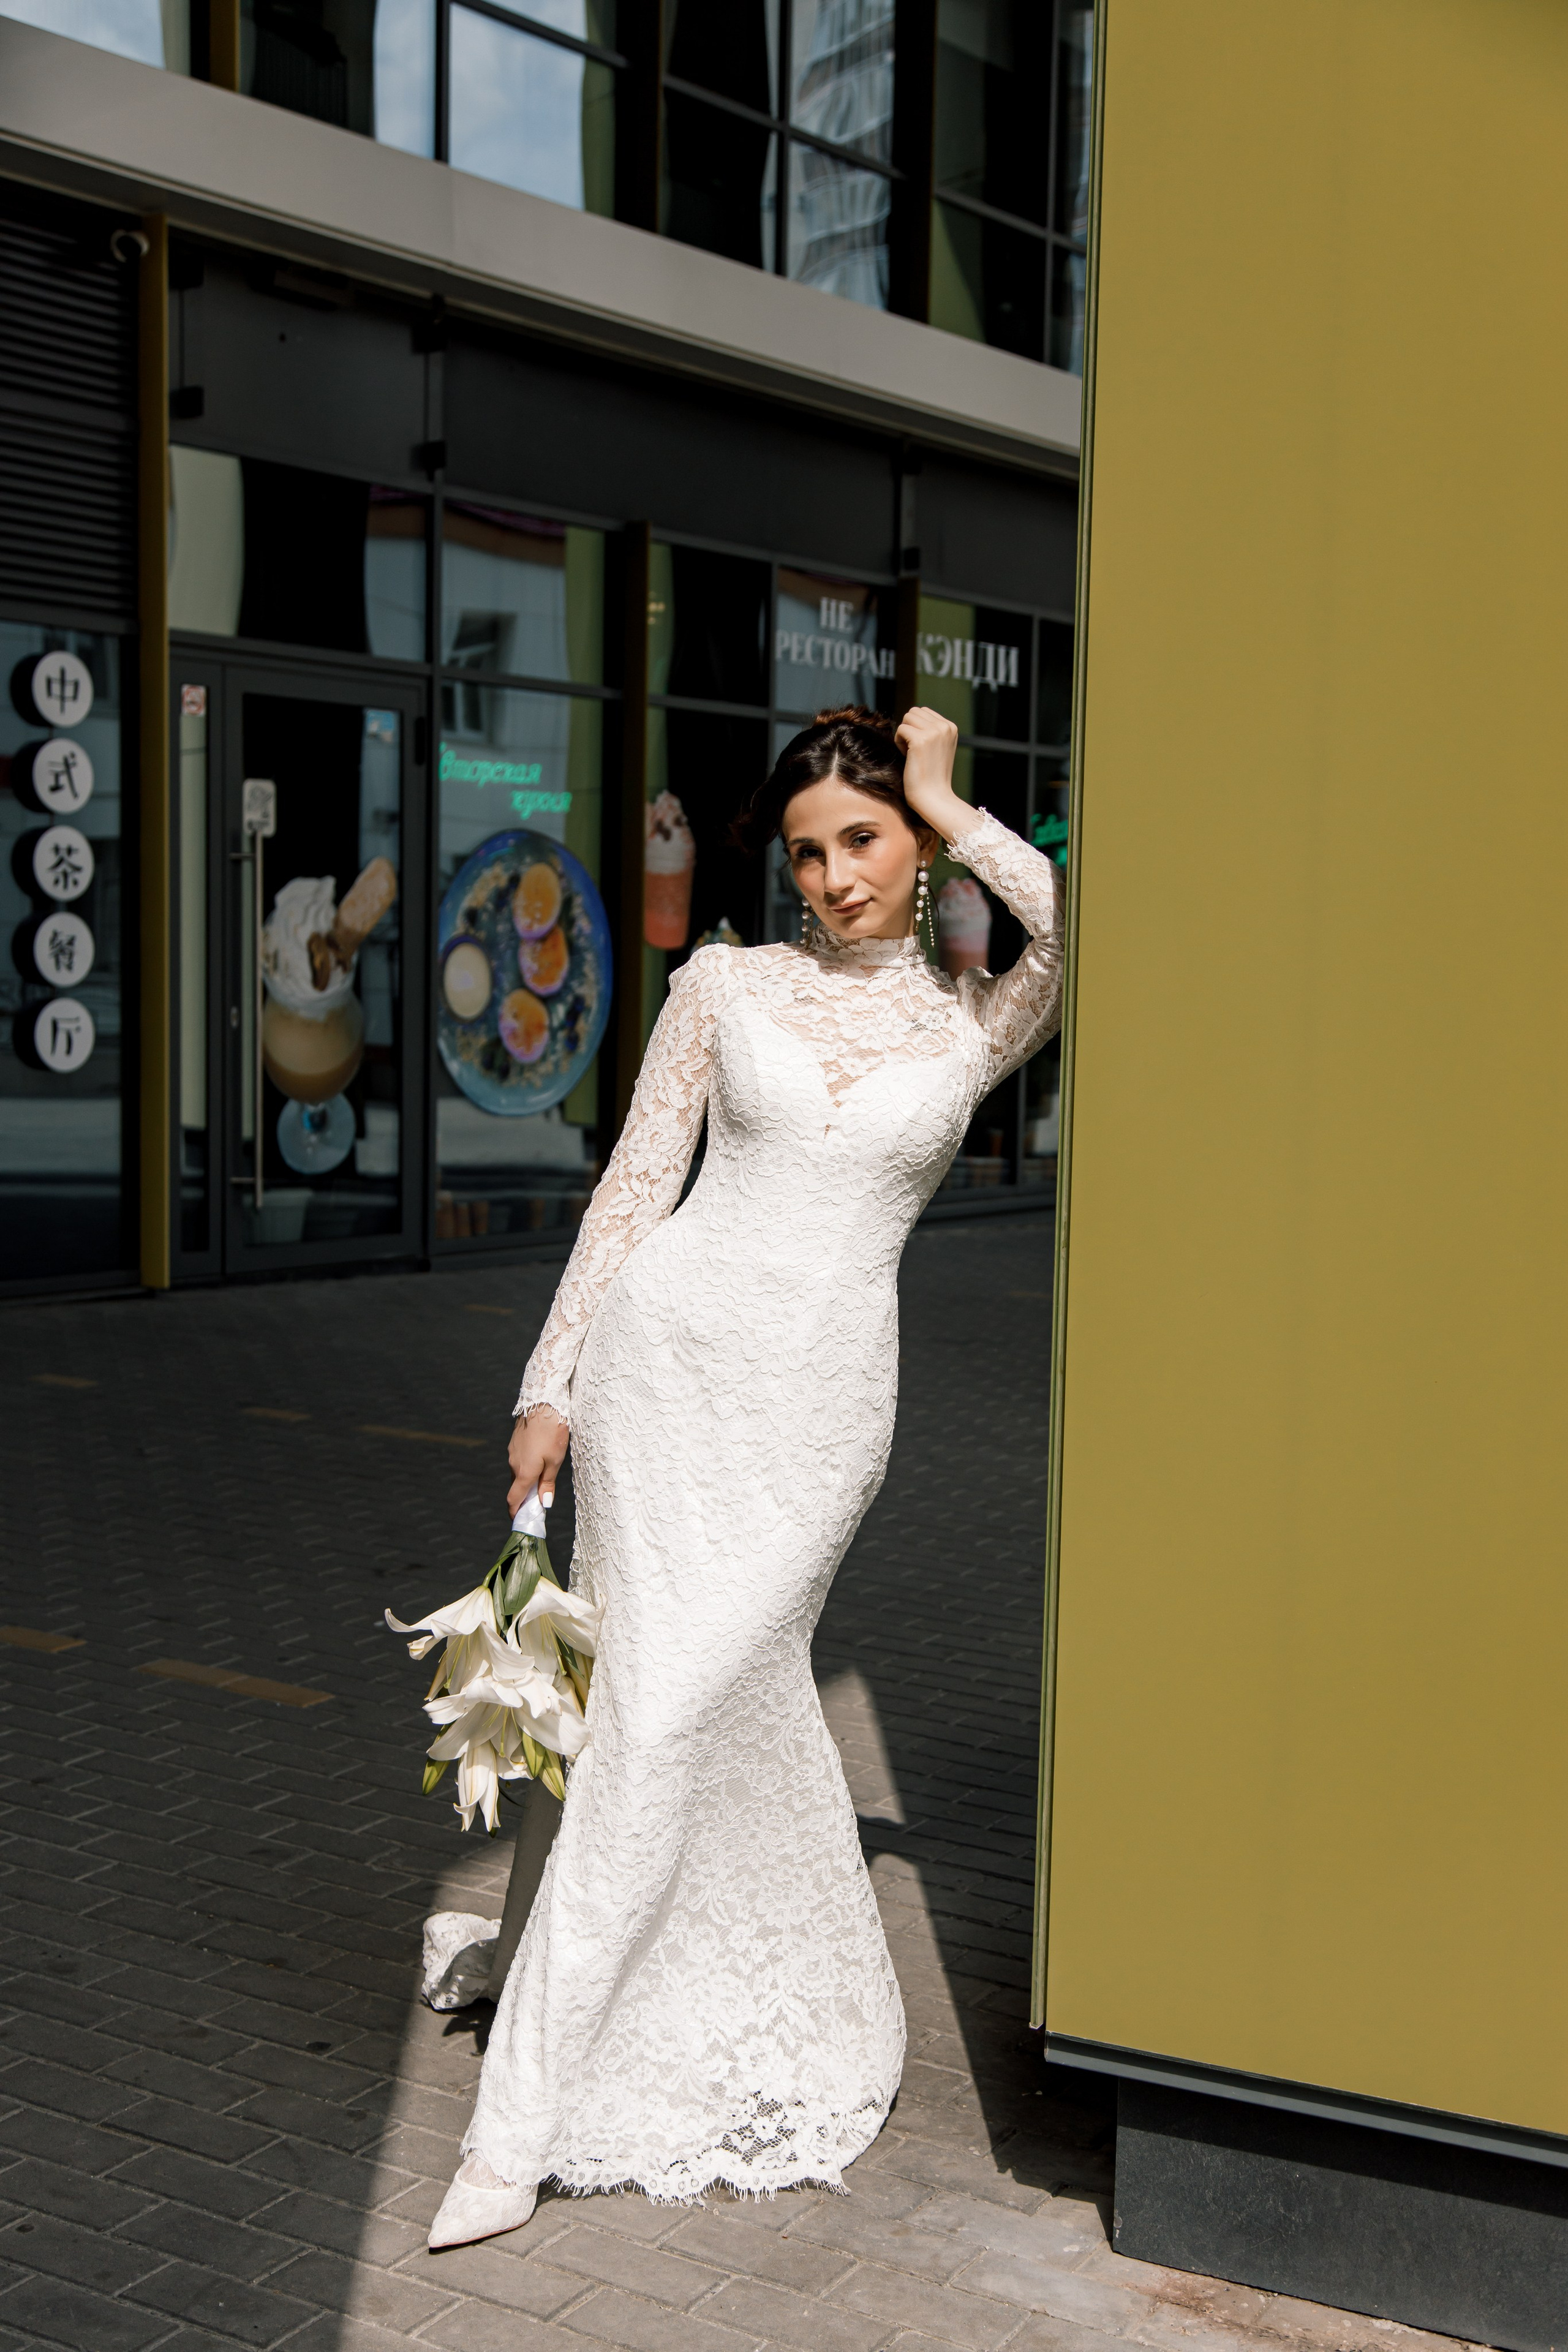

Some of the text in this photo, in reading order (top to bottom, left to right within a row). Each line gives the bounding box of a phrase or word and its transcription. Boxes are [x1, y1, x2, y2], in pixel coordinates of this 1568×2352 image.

[820, 597, 854, 632] НЕ
[775, 629, 896, 679] РЕСТОРАН
[916, 631, 1019, 692] КЭНДИ
